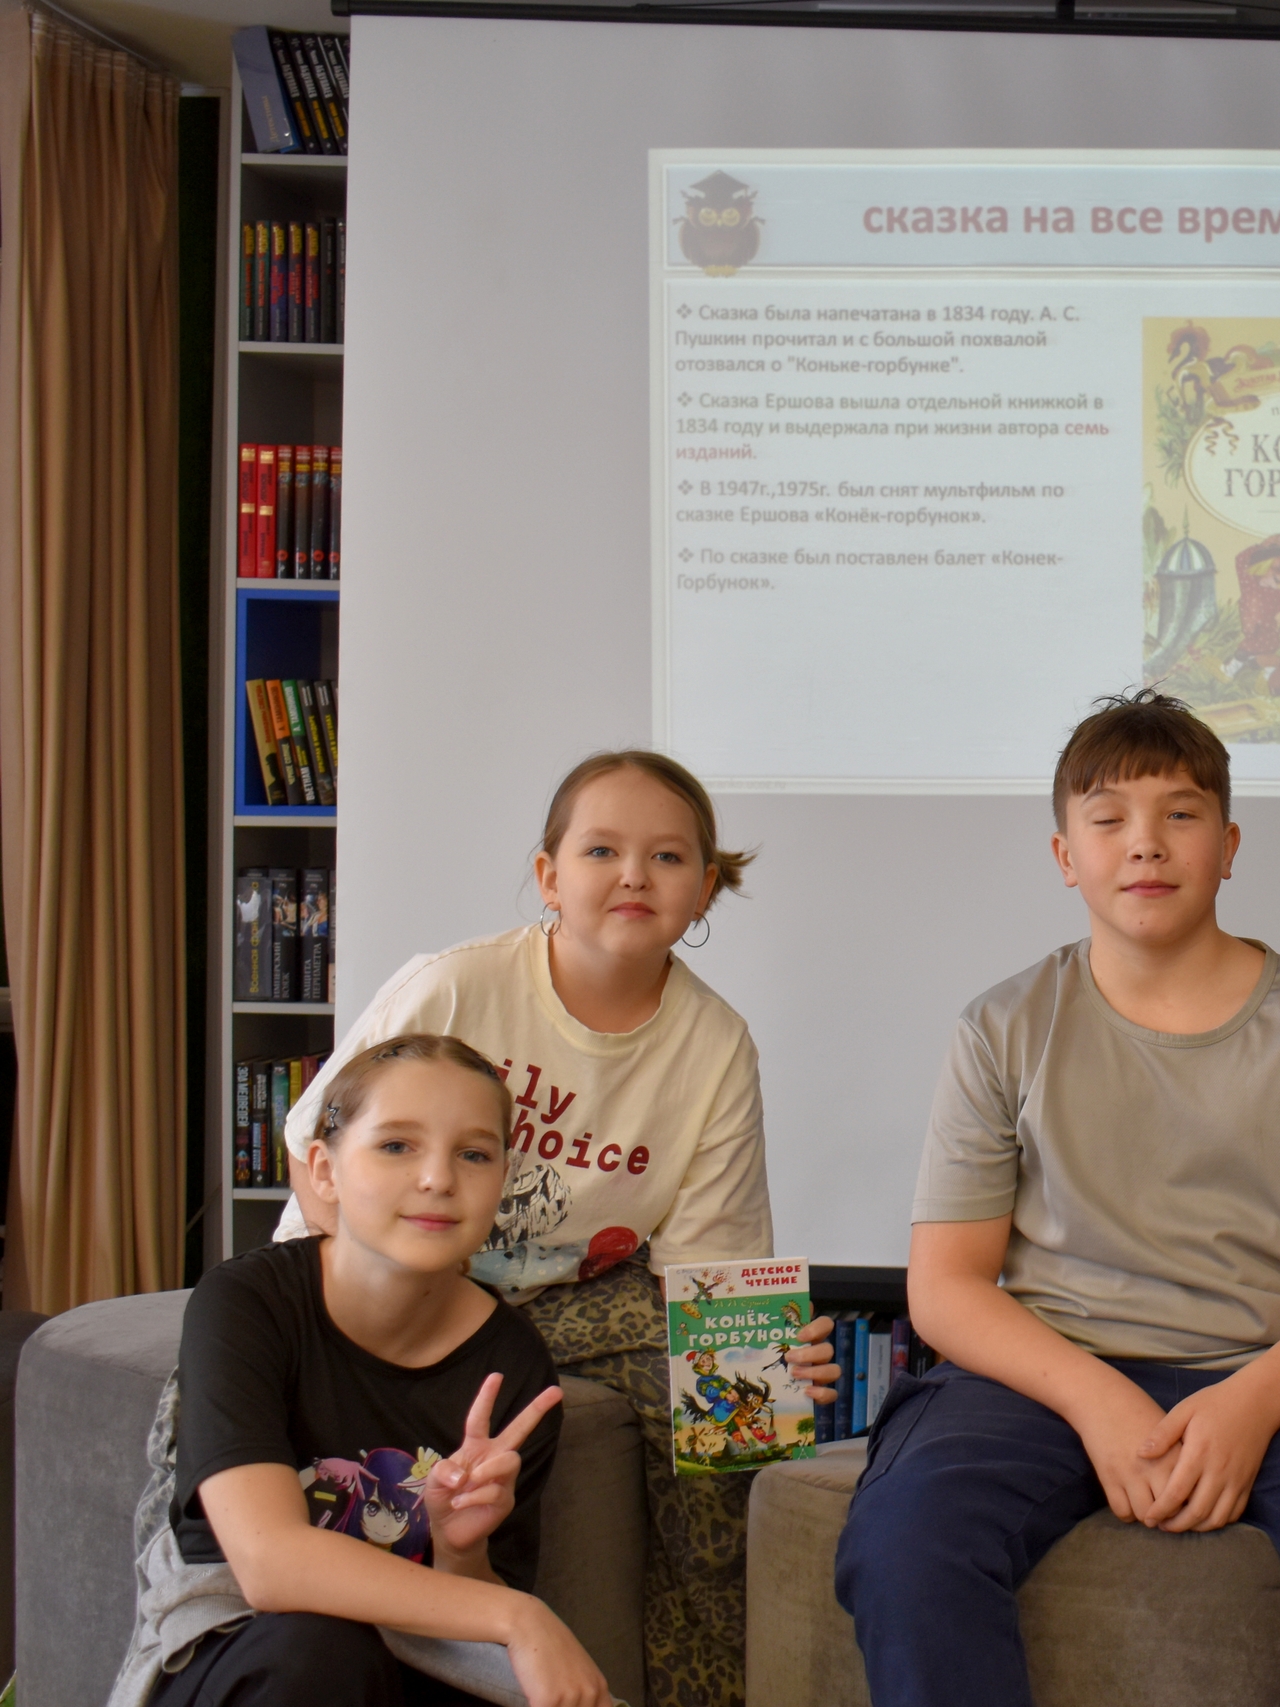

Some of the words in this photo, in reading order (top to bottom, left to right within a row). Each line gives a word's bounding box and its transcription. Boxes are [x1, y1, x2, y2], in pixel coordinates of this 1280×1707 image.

[863, 205, 1009, 236] сказка
[1023, 206, 1075, 236] на
[1091, 206, 1164, 236] все
[699, 303, 759, 321] Сказка
[765, 304, 811, 322] была
[817, 308, 922, 322] напечатана
[927, 309, 937, 322] в
[943, 305, 985, 322] 1834
[991, 309, 1034, 326] году.
[1040, 305, 1058, 322] А.
[1063, 305, 1080, 322] С.
[675, 330, 746, 350] Пушкин
[752, 334, 838, 351] прочитал
[842, 335, 854, 348] и
[859, 335, 869, 348] с
[873, 329, 956, 348] большой
[960, 329, 1051, 349] похвалой
[675, 358, 766, 373] отозвался
[770, 359, 783, 373] о
[787, 355, 965, 377] "Коньке-горбунке".
[699, 392, 760, 410] Сказка
[765, 392, 834, 412] Ершова
[839, 396, 900, 410] вышла
[906, 393, 1002, 414] отдельной
[1008, 393, 1089, 411] книжкой
[1095, 398, 1105, 411] в
[677, 418, 718, 435] 1834
[724, 422, 764, 439] году
[769, 422, 780, 435] и
[785, 422, 890, 440] выдержала
[895, 423, 929, 439] при
[934, 423, 992, 437] жизни
[998, 423, 1060, 439] автора
[1065, 424, 1111, 437] семь
[676, 443, 757, 463] изданий.
[700, 480, 712, 498] В
[717, 480, 830, 500] 1947г.,1975г.
[838, 480, 875, 498] был
[880, 485, 919, 498] снят
[924, 482, 1036, 503] мультфильм
[1042, 486, 1065, 499] по
[676, 509, 735, 523] сказке
[739, 506, 810, 526] Ершова
[814, 506, 986, 528] «Конёк-горбунок».
[700, 548, 725, 565] По
[729, 551, 789, 566] сказке
[793, 547, 831, 566] был
[835, 552, 929, 567] поставлен
[934, 549, 986, 567] балет
[991, 549, 1065, 567] «Конек-
[676, 573, 776, 594] Горбунок».
[300, 766, 315, 801] ВЬЕТНАМ
[249, 949, 259, 993] Военная
[509, 1108, 650, 1176] hoice
[741, 1264, 802, 1279] ДЕТСКОЕ
[745, 1276, 798, 1288] ЧТЕНИЕ
[704, 1310, 780, 1330] КОНЁК-
[688, 1326, 799, 1348] ГОРБУНОК
